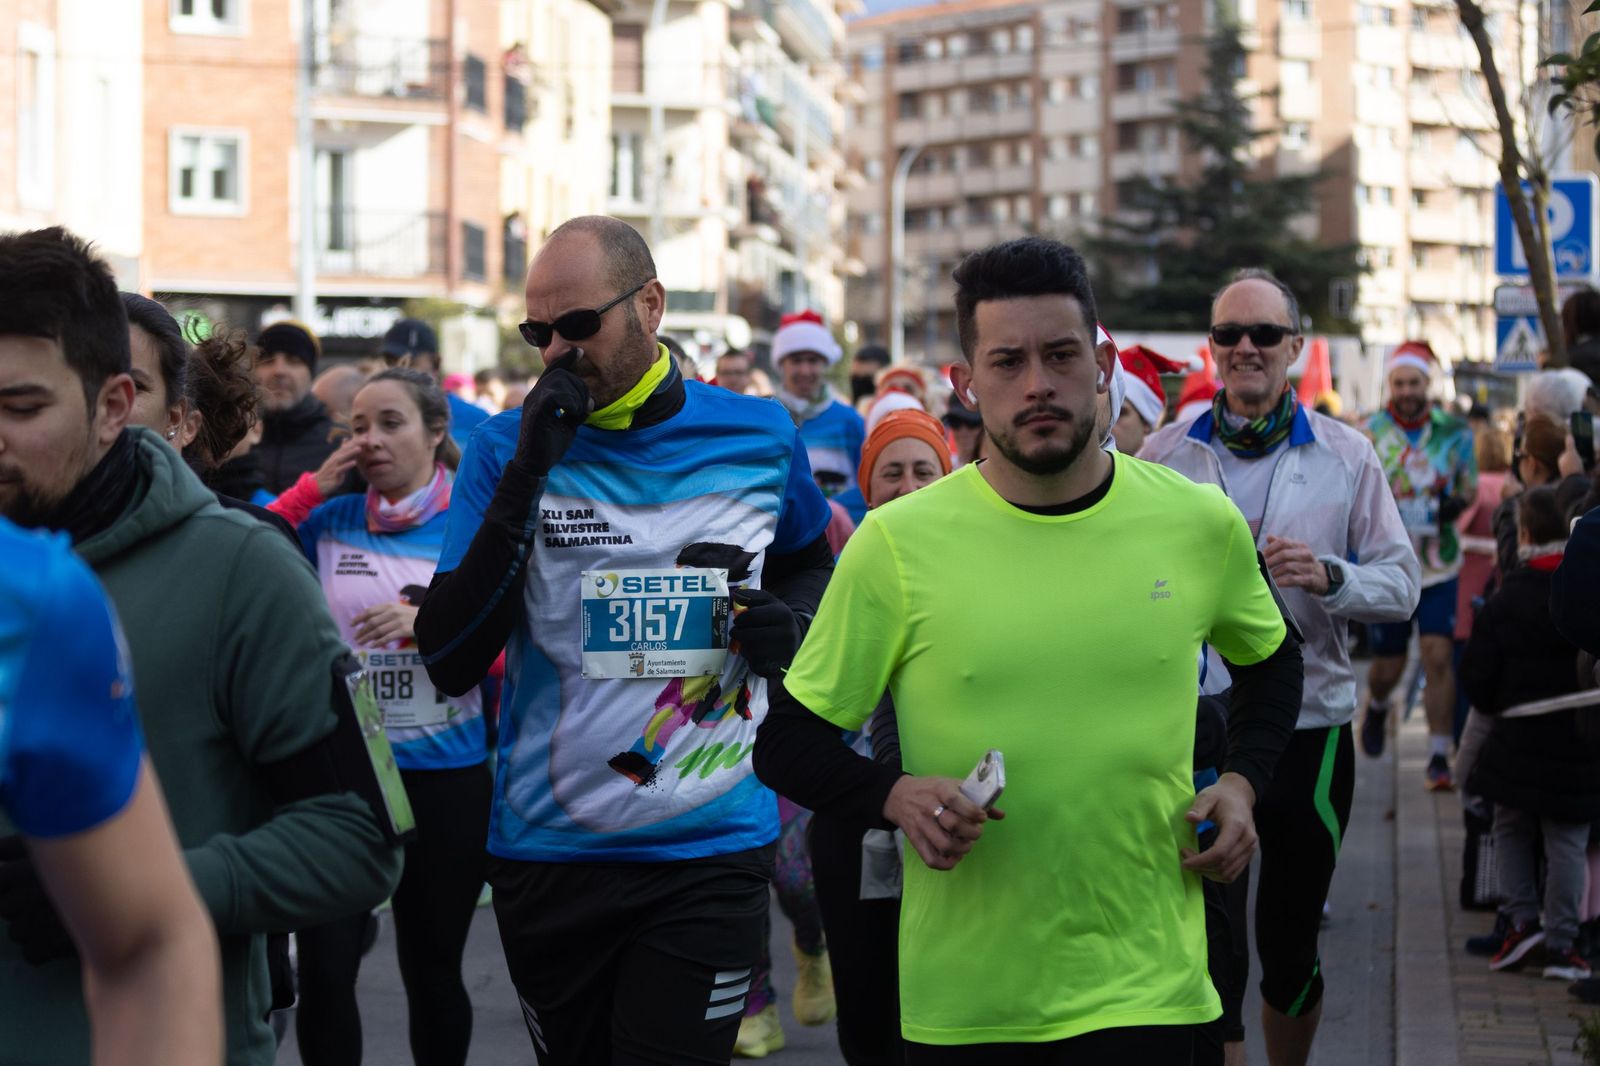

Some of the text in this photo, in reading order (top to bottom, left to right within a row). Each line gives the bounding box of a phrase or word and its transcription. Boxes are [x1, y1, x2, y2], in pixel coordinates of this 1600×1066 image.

[542, 509, 594, 520] XLI SAN
[543, 522, 610, 534] SILVESTRE
[545, 535, 634, 548] SALMANTINA
[622, 575, 716, 594] SETEL
[609, 598, 690, 642] 3157
[630, 641, 668, 651] CARLOS
[369, 653, 424, 667] SETE
[647, 659, 687, 668] Ayuntamiento
[656, 667, 686, 675] Salamanca
